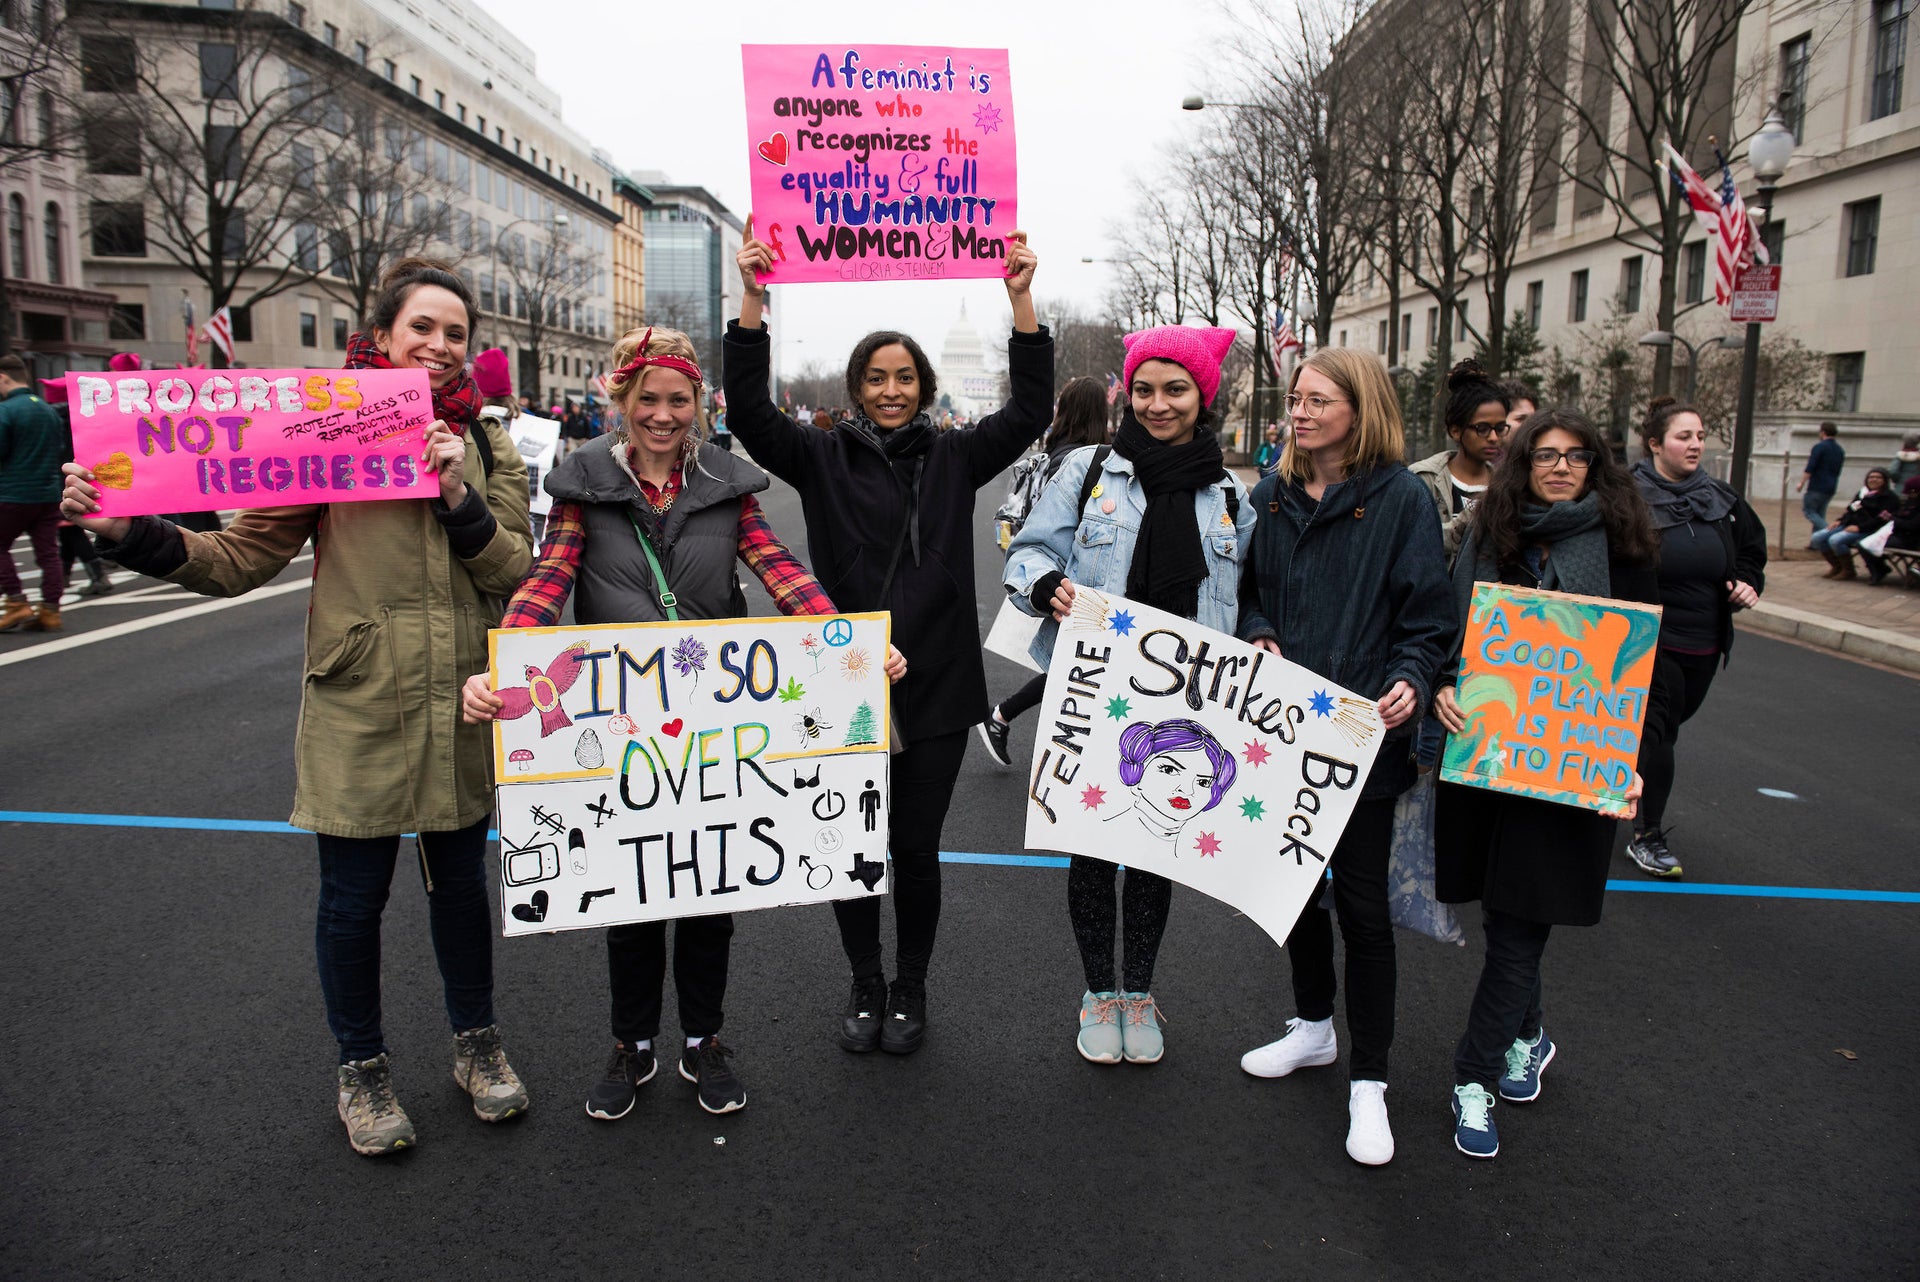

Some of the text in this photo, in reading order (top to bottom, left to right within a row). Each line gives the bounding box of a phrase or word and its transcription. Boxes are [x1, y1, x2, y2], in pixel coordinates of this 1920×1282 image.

[811, 50, 991, 93] A feminist is
[773, 94, 922, 127] anyone who
[797, 127, 978, 163] recognizes the
[781, 153, 977, 203] equality & full
[765, 222, 786, 262] f
[924, 221, 951, 260] &
[952, 225, 1005, 259] Men
[896, 262, 945, 276] STEINEM
[1742, 282, 1772, 290] ROUTE
[76, 375, 364, 417] PROGRESS
[282, 390, 420, 440] PROTECT ACCESS TO
[137, 415, 252, 456] NOT
[317, 411, 402, 442] REPRODUCTIVE
[197, 455, 419, 494] REGRESS
[1482, 607, 1510, 636] A
[1480, 635, 1584, 675] GOOD
[573, 639, 778, 720] I'M SO
[1129, 629, 1305, 745] Strikes
[1528, 676, 1649, 723] PLANET
[1516, 713, 1638, 753] IS HARD
[619, 722, 789, 811] OVER
[1504, 741, 1634, 792] TO FIND
[1279, 749, 1359, 866] Back
[618, 817, 785, 905] THIS
